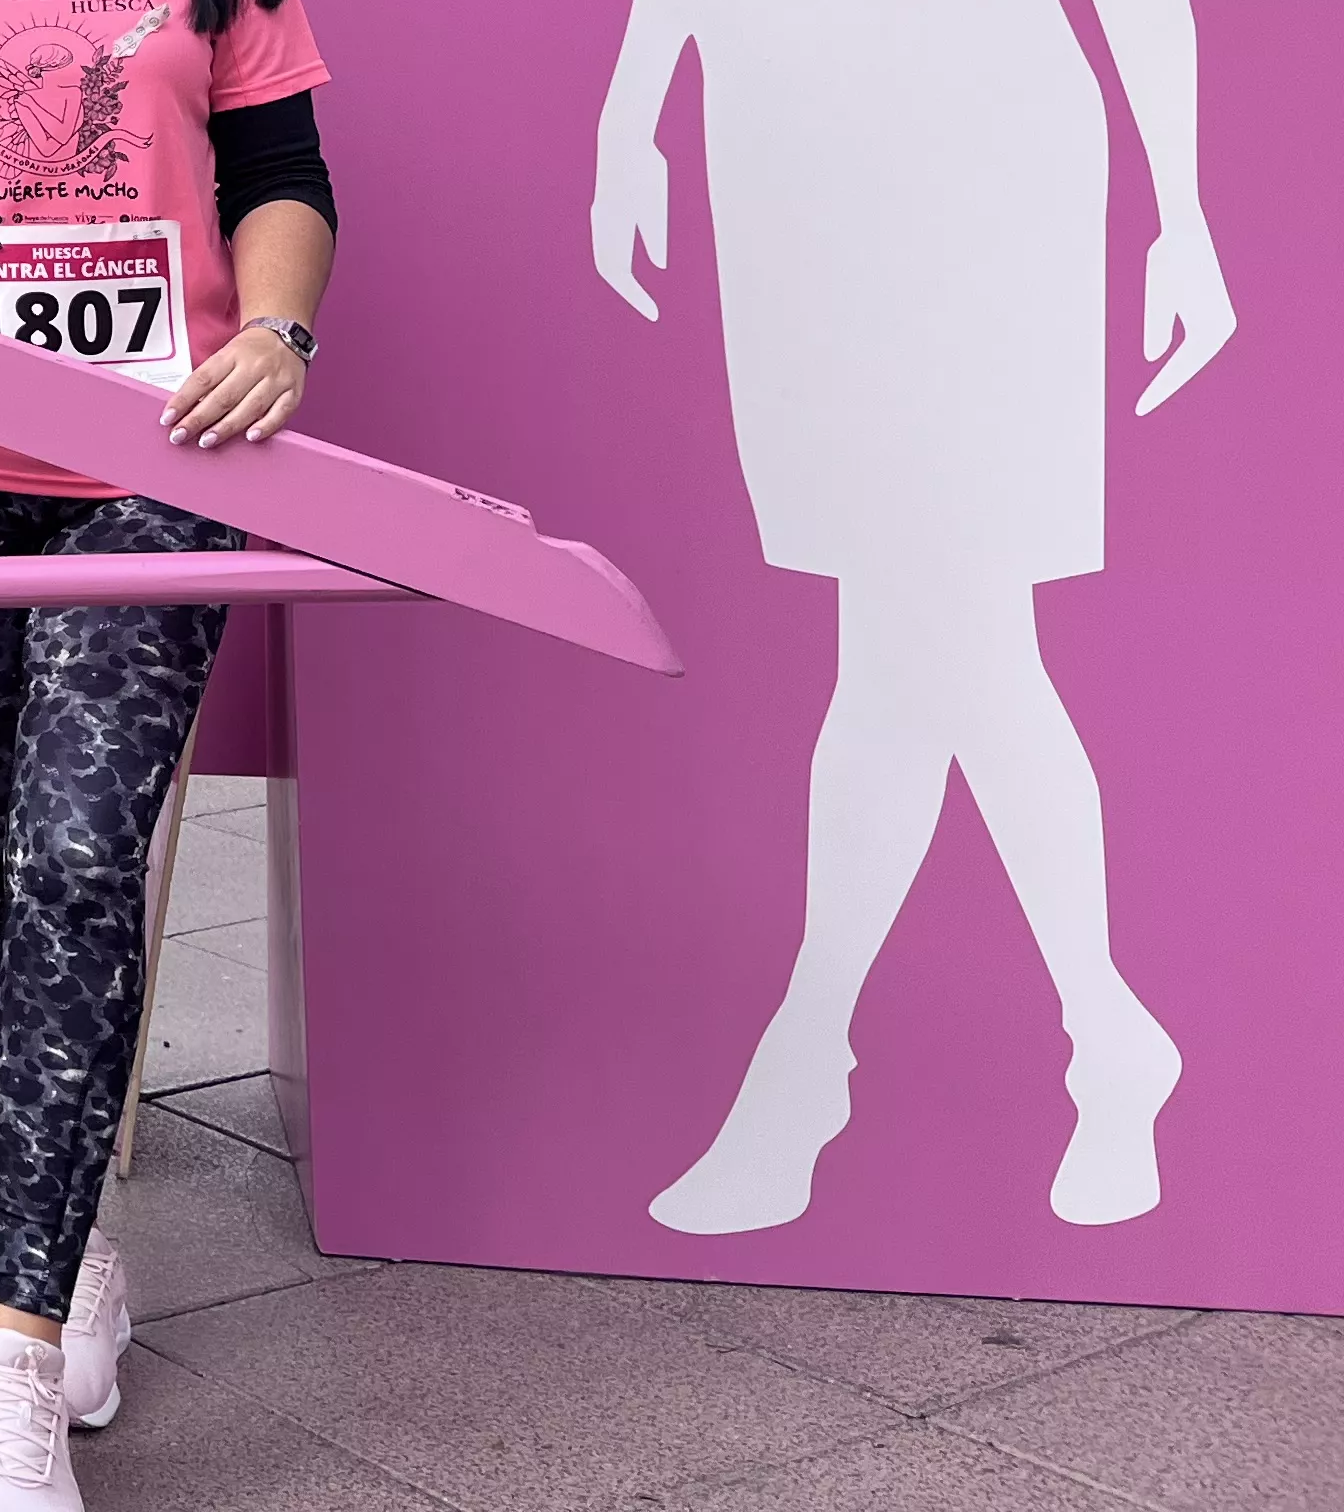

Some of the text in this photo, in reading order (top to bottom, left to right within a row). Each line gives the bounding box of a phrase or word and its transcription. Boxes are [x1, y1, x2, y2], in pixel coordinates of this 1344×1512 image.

[75, 182, 139, 200] MUCHO
[32, 246, 92, 261] HUESCA
[54, 264, 75, 278] EL
[81, 257, 159, 276] CÁNCER
